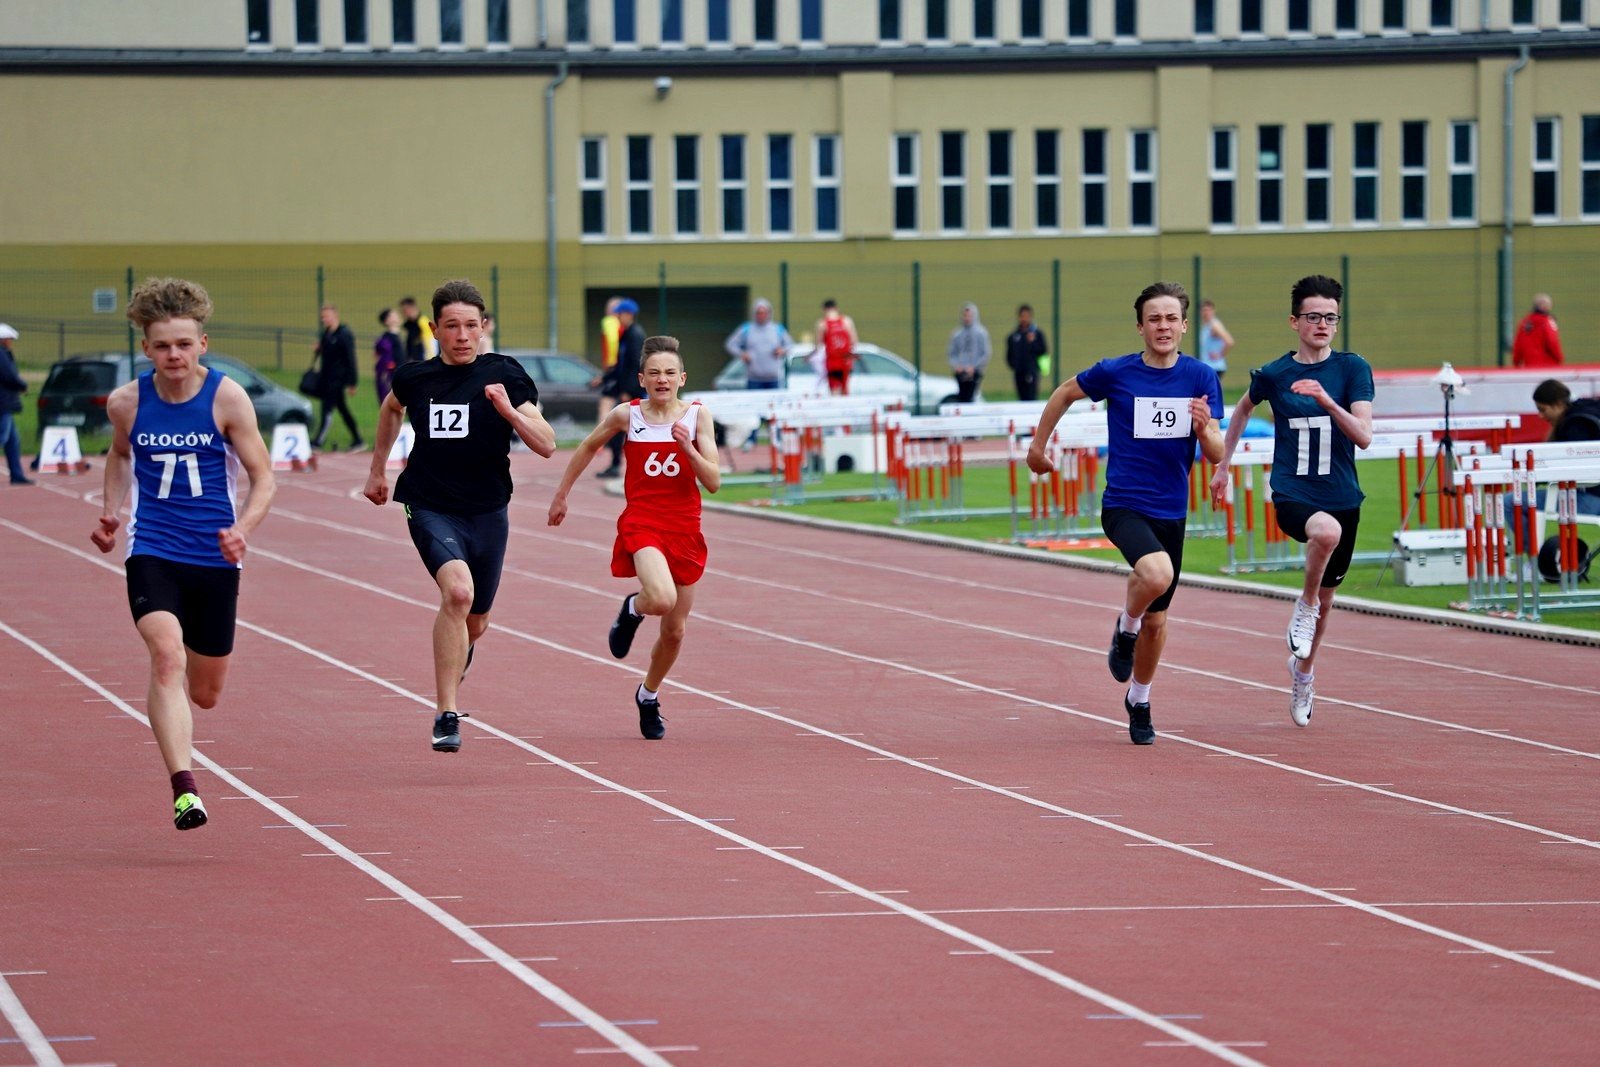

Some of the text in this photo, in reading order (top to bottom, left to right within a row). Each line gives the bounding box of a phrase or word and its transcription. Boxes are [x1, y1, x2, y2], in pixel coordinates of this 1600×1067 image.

[434, 409, 463, 432] 12
[1151, 410, 1176, 428] 49
[52, 438, 67, 462] 4
[137, 432, 214, 447] GŁOGÓW
[284, 435, 298, 459] 2
[398, 435, 407, 457] 1
[150, 452, 204, 499] 71
[644, 451, 681, 477] 66
